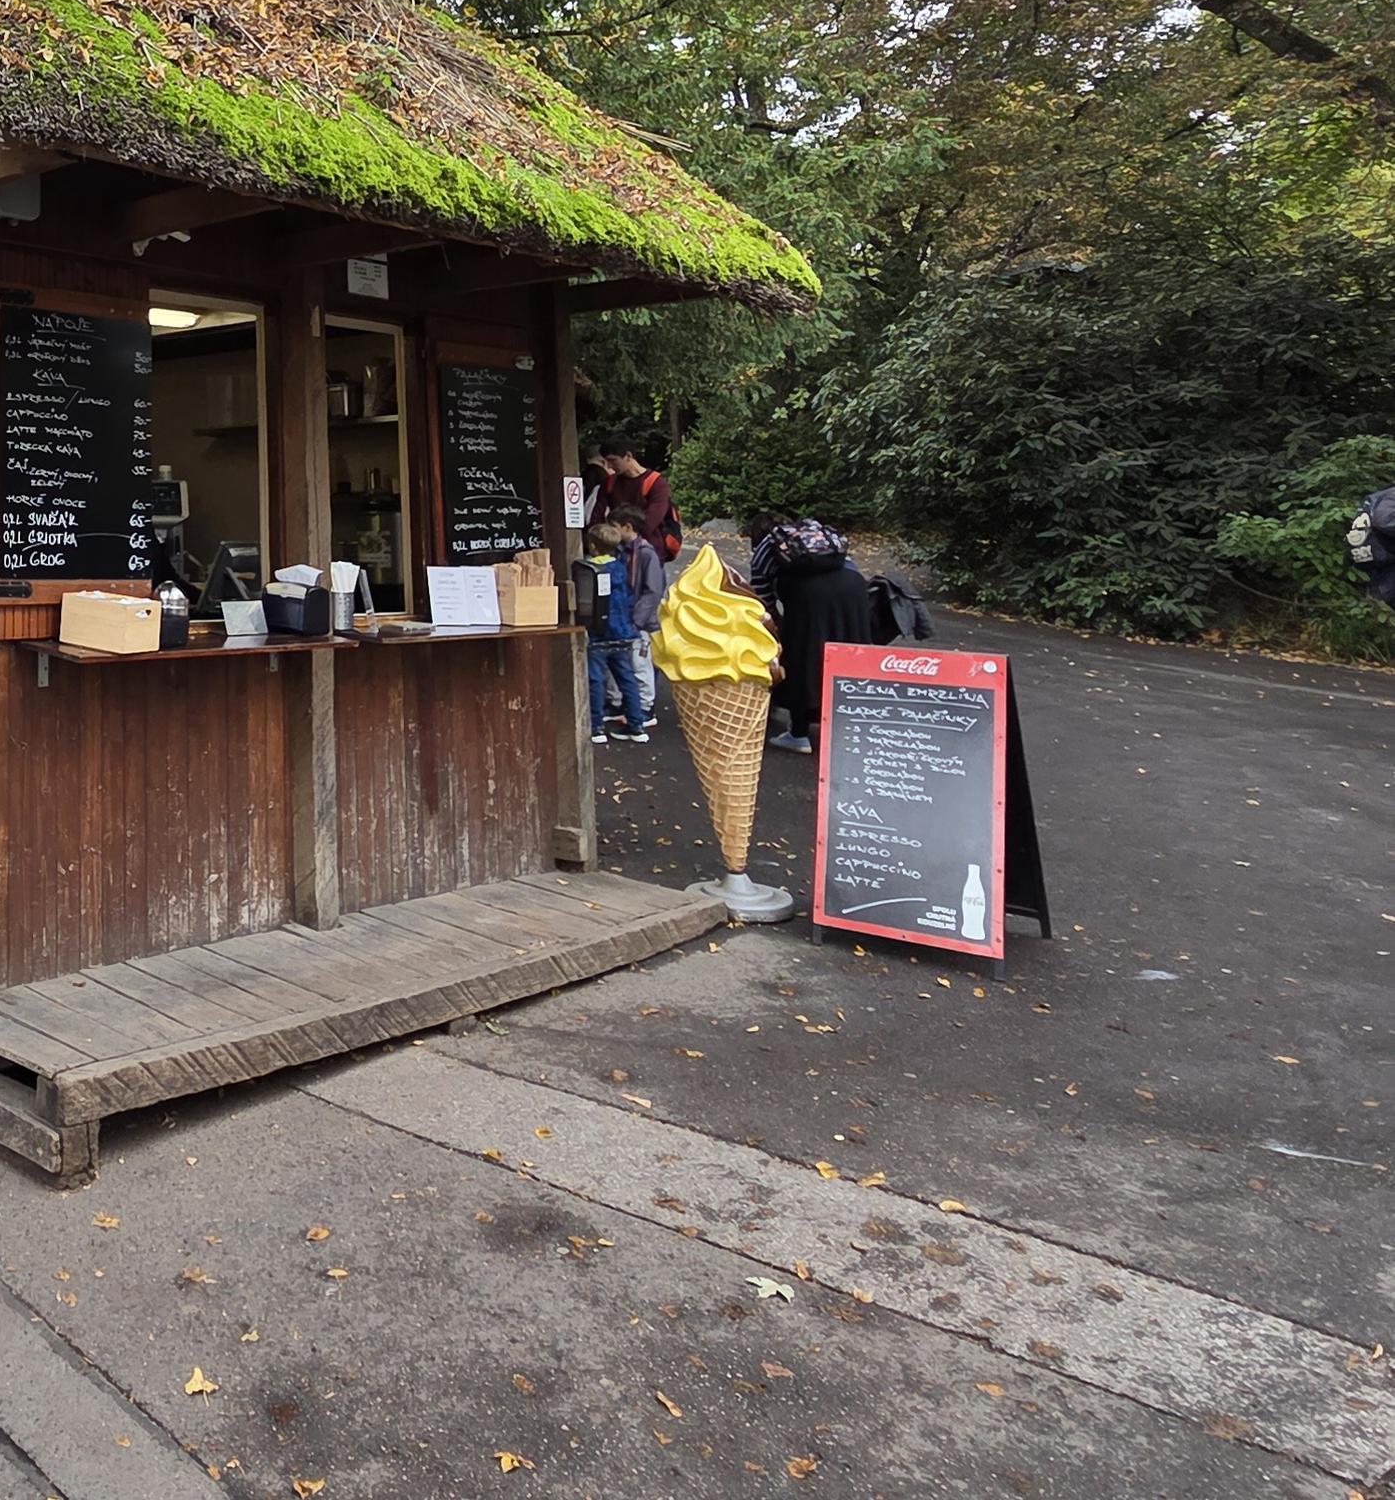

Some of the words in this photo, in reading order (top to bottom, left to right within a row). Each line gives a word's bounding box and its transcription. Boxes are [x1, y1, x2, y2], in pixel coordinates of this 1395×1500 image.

[27, 529, 79, 548] GRIOTKA
[3, 553, 28, 570] 0,2L
[29, 551, 66, 567] GROG
[880, 654, 942, 676] Coca-Cola
[837, 680, 900, 699] TOČENÁ
[907, 687, 990, 709] ZMRZLINA
[836, 705, 893, 719] SLADKÉ
[897, 709, 978, 732] PALAČINKY
[836, 799, 884, 824] KÁVA
[836, 827, 922, 848] ESPRESSO
[835, 842, 891, 857] LUNGO
[835, 857, 922, 880] CAPPUCCINO
